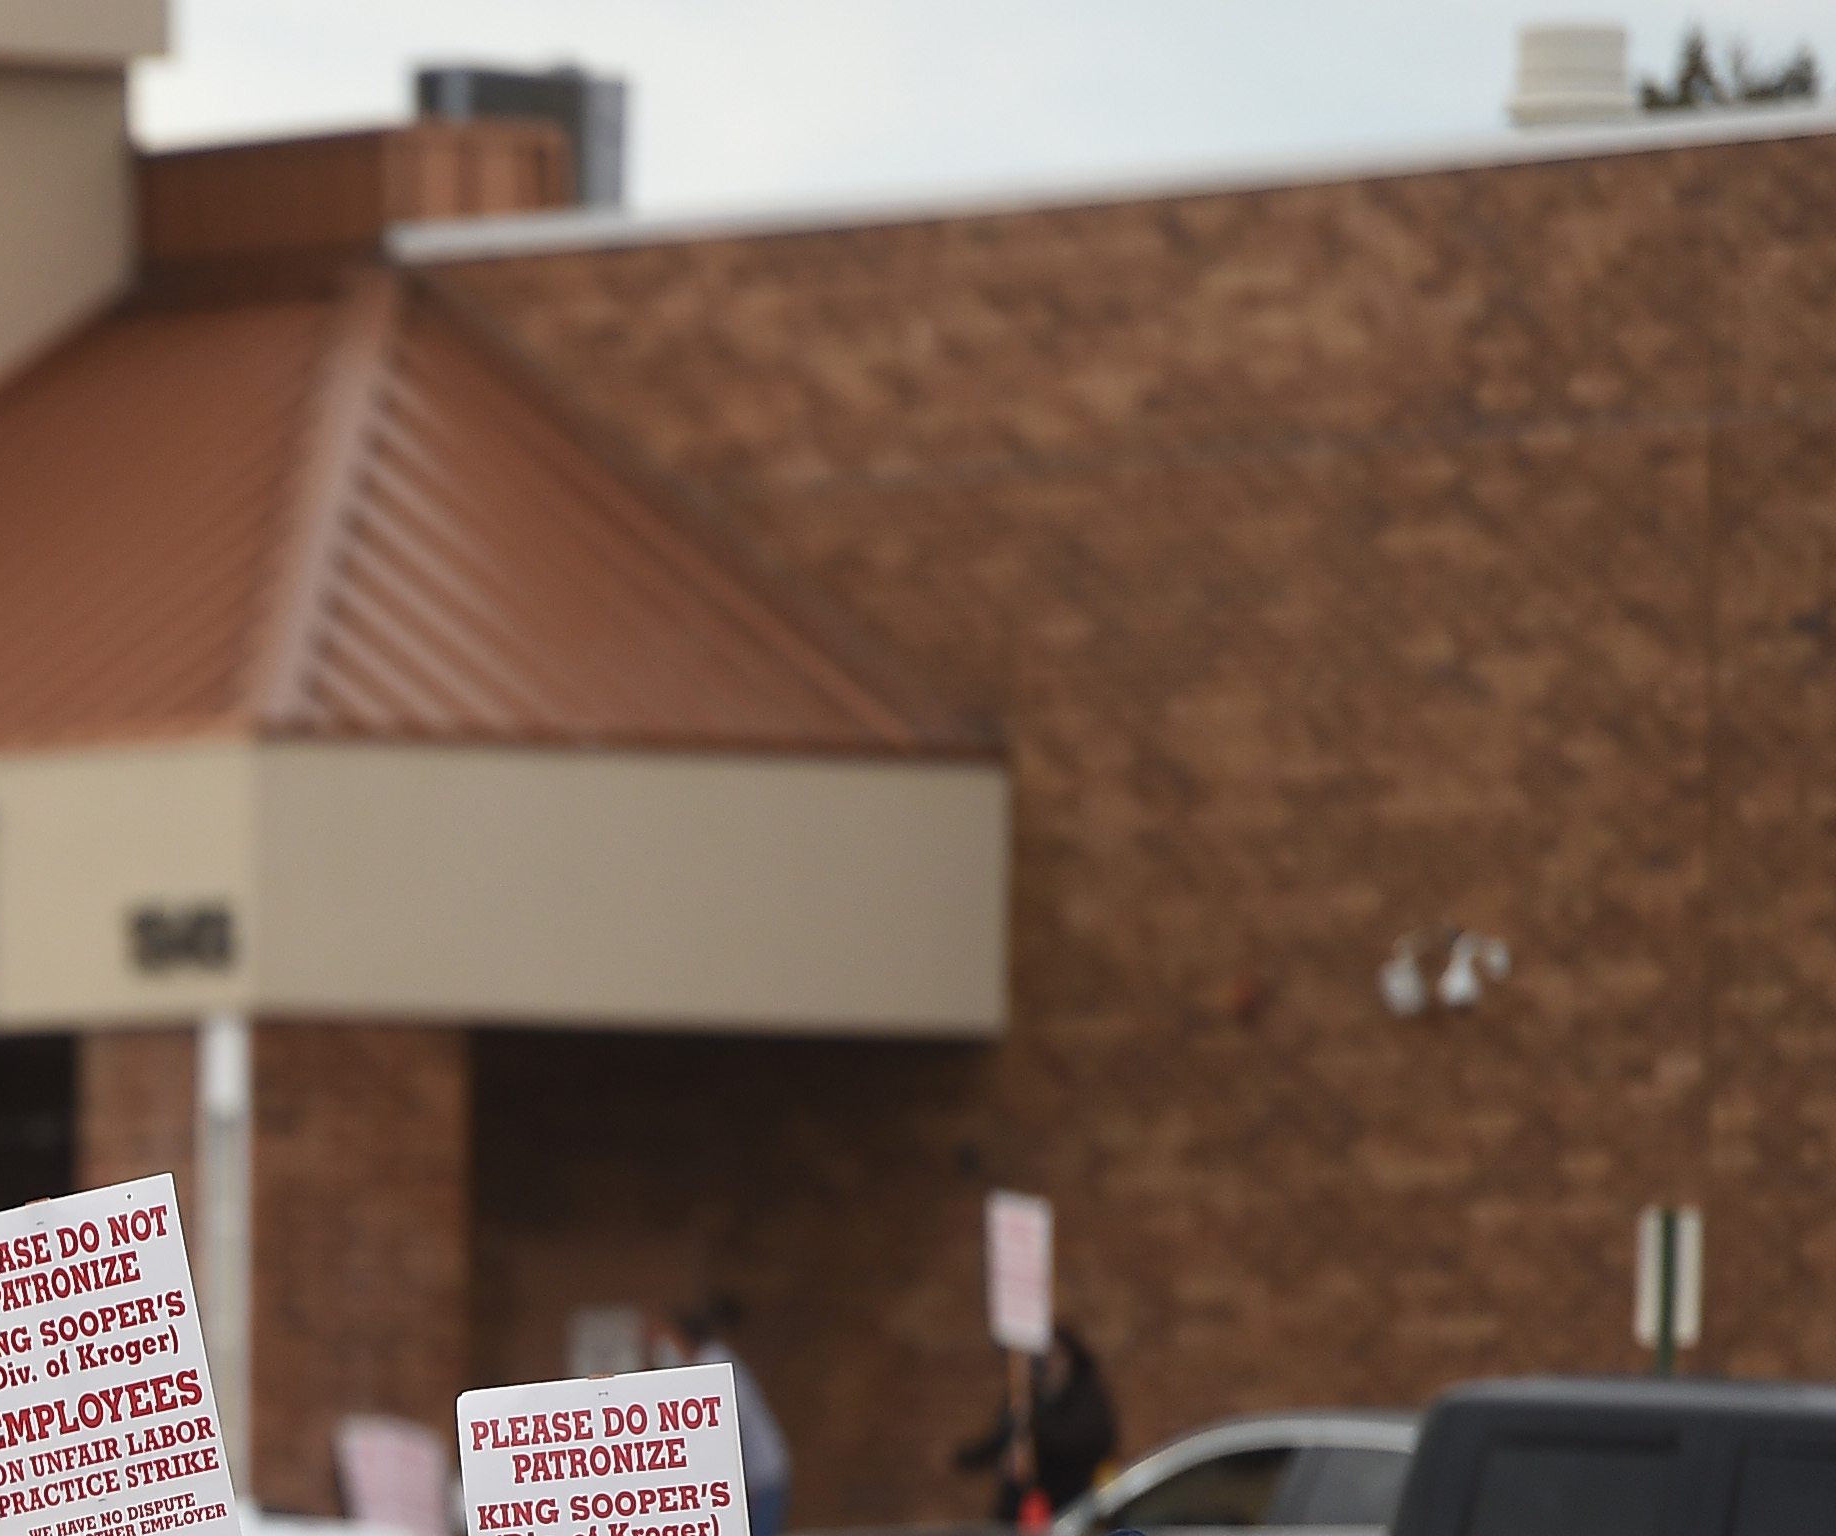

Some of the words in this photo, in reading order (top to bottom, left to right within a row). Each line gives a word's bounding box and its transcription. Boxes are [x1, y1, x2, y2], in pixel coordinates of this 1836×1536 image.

[56, 1221, 100, 1259] DO
[107, 1204, 167, 1247] NOT
[39, 1290, 186, 1347] SOOPER'S
[46, 1349, 70, 1378] of
[76, 1325, 178, 1370] Kroger)
[29, 1437, 122, 1477] UNFAIR
[125, 1416, 215, 1456] LABOR
[470, 1409, 593, 1451] PLEASE
[602, 1403, 648, 1437] DO
[657, 1396, 721, 1432] NOT
[124, 1446, 219, 1488] STRIKE
[512, 1437, 687, 1484] PATRONIZE
[57, 1516, 96, 1536] HAVE
[100, 1510, 123, 1526] NO
[127, 1493, 195, 1520] DISPUTE
[140, 1503, 227, 1535] EMPLOYER
[477, 1498, 559, 1530] KING
[569, 1481, 731, 1521] SOOPER'S
